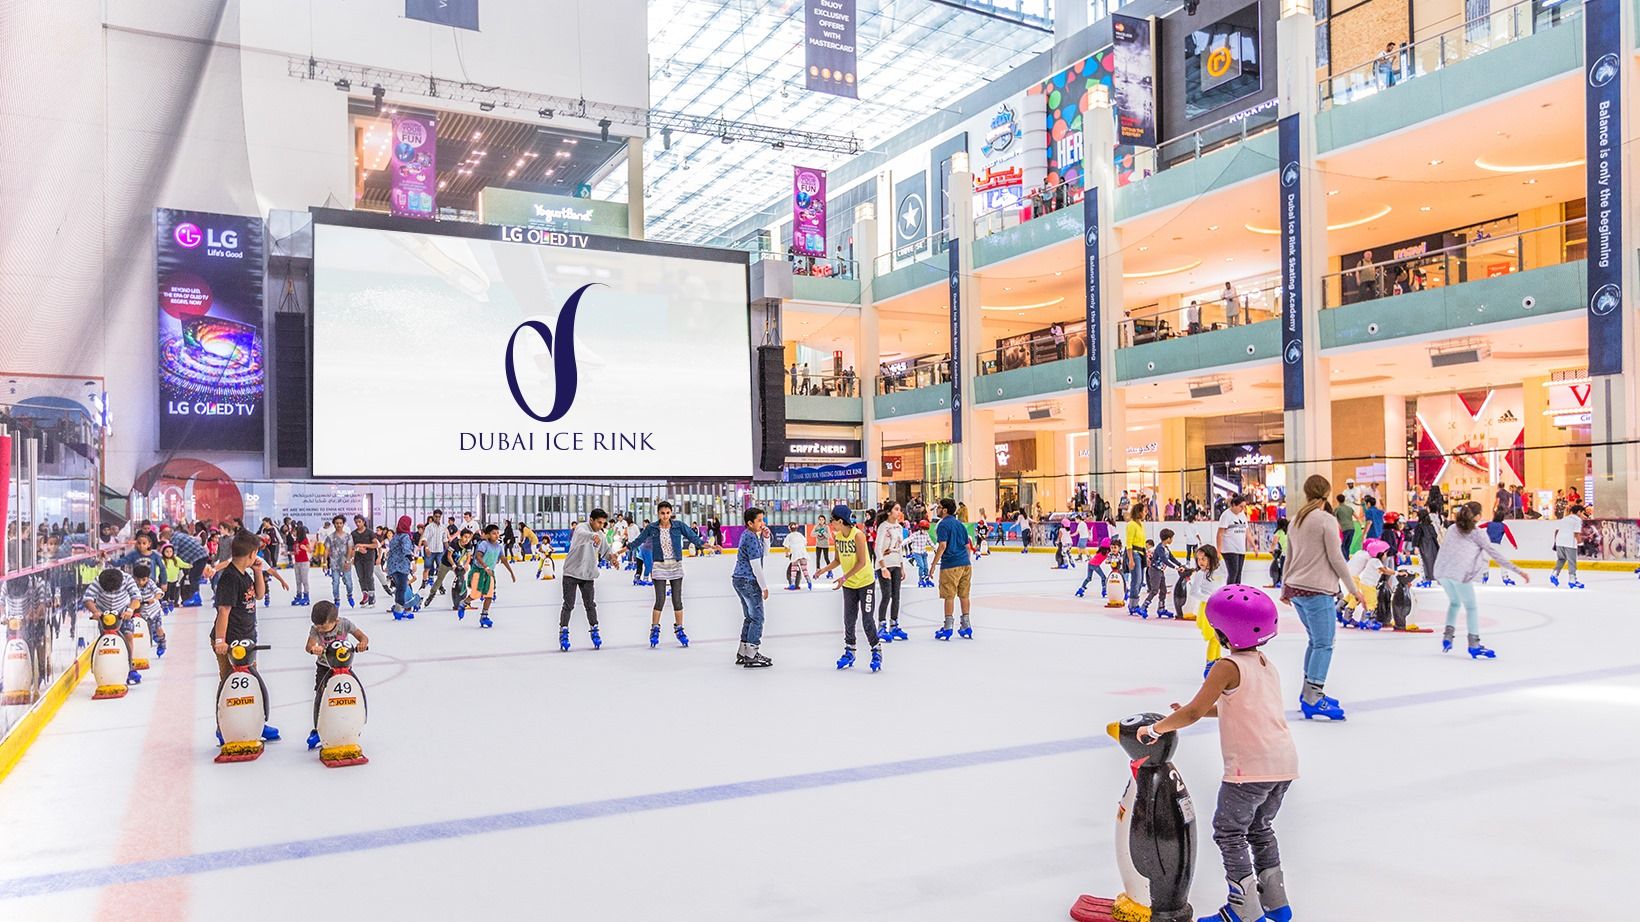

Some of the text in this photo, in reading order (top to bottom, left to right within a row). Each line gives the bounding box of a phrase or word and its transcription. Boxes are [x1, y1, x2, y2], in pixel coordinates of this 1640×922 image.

[813, 8, 850, 22] EXCLUSIVE
[818, 19, 846, 31] OFFERS
[822, 30, 842, 40] WITH
[808, 37, 854, 53] MASTERCARD
[401, 134, 423, 145] FUN
[800, 184, 817, 193] FUN
[1598, 100, 1612, 268] Balance is only the beginning
[206, 228, 239, 249] LG
[501, 226, 589, 248] LG OLED TV
[206, 248, 244, 259] Life's Good
[1287, 193, 1297, 332] Dubai Ice Rink Skating Academy
[168, 401, 255, 416] LG OLED TV
[459, 431, 657, 451] DUBAI ICE RINK
[820, 446, 847, 454] NERO
[1234, 453, 1273, 467] adidas
[1601, 520, 1617, 529] GET
[103, 637, 116, 647] 21
[231, 677, 250, 690] 56
[333, 682, 352, 694] 49
[233, 697, 254, 706] JOTUN
[335, 698, 357, 706] JOTUN
